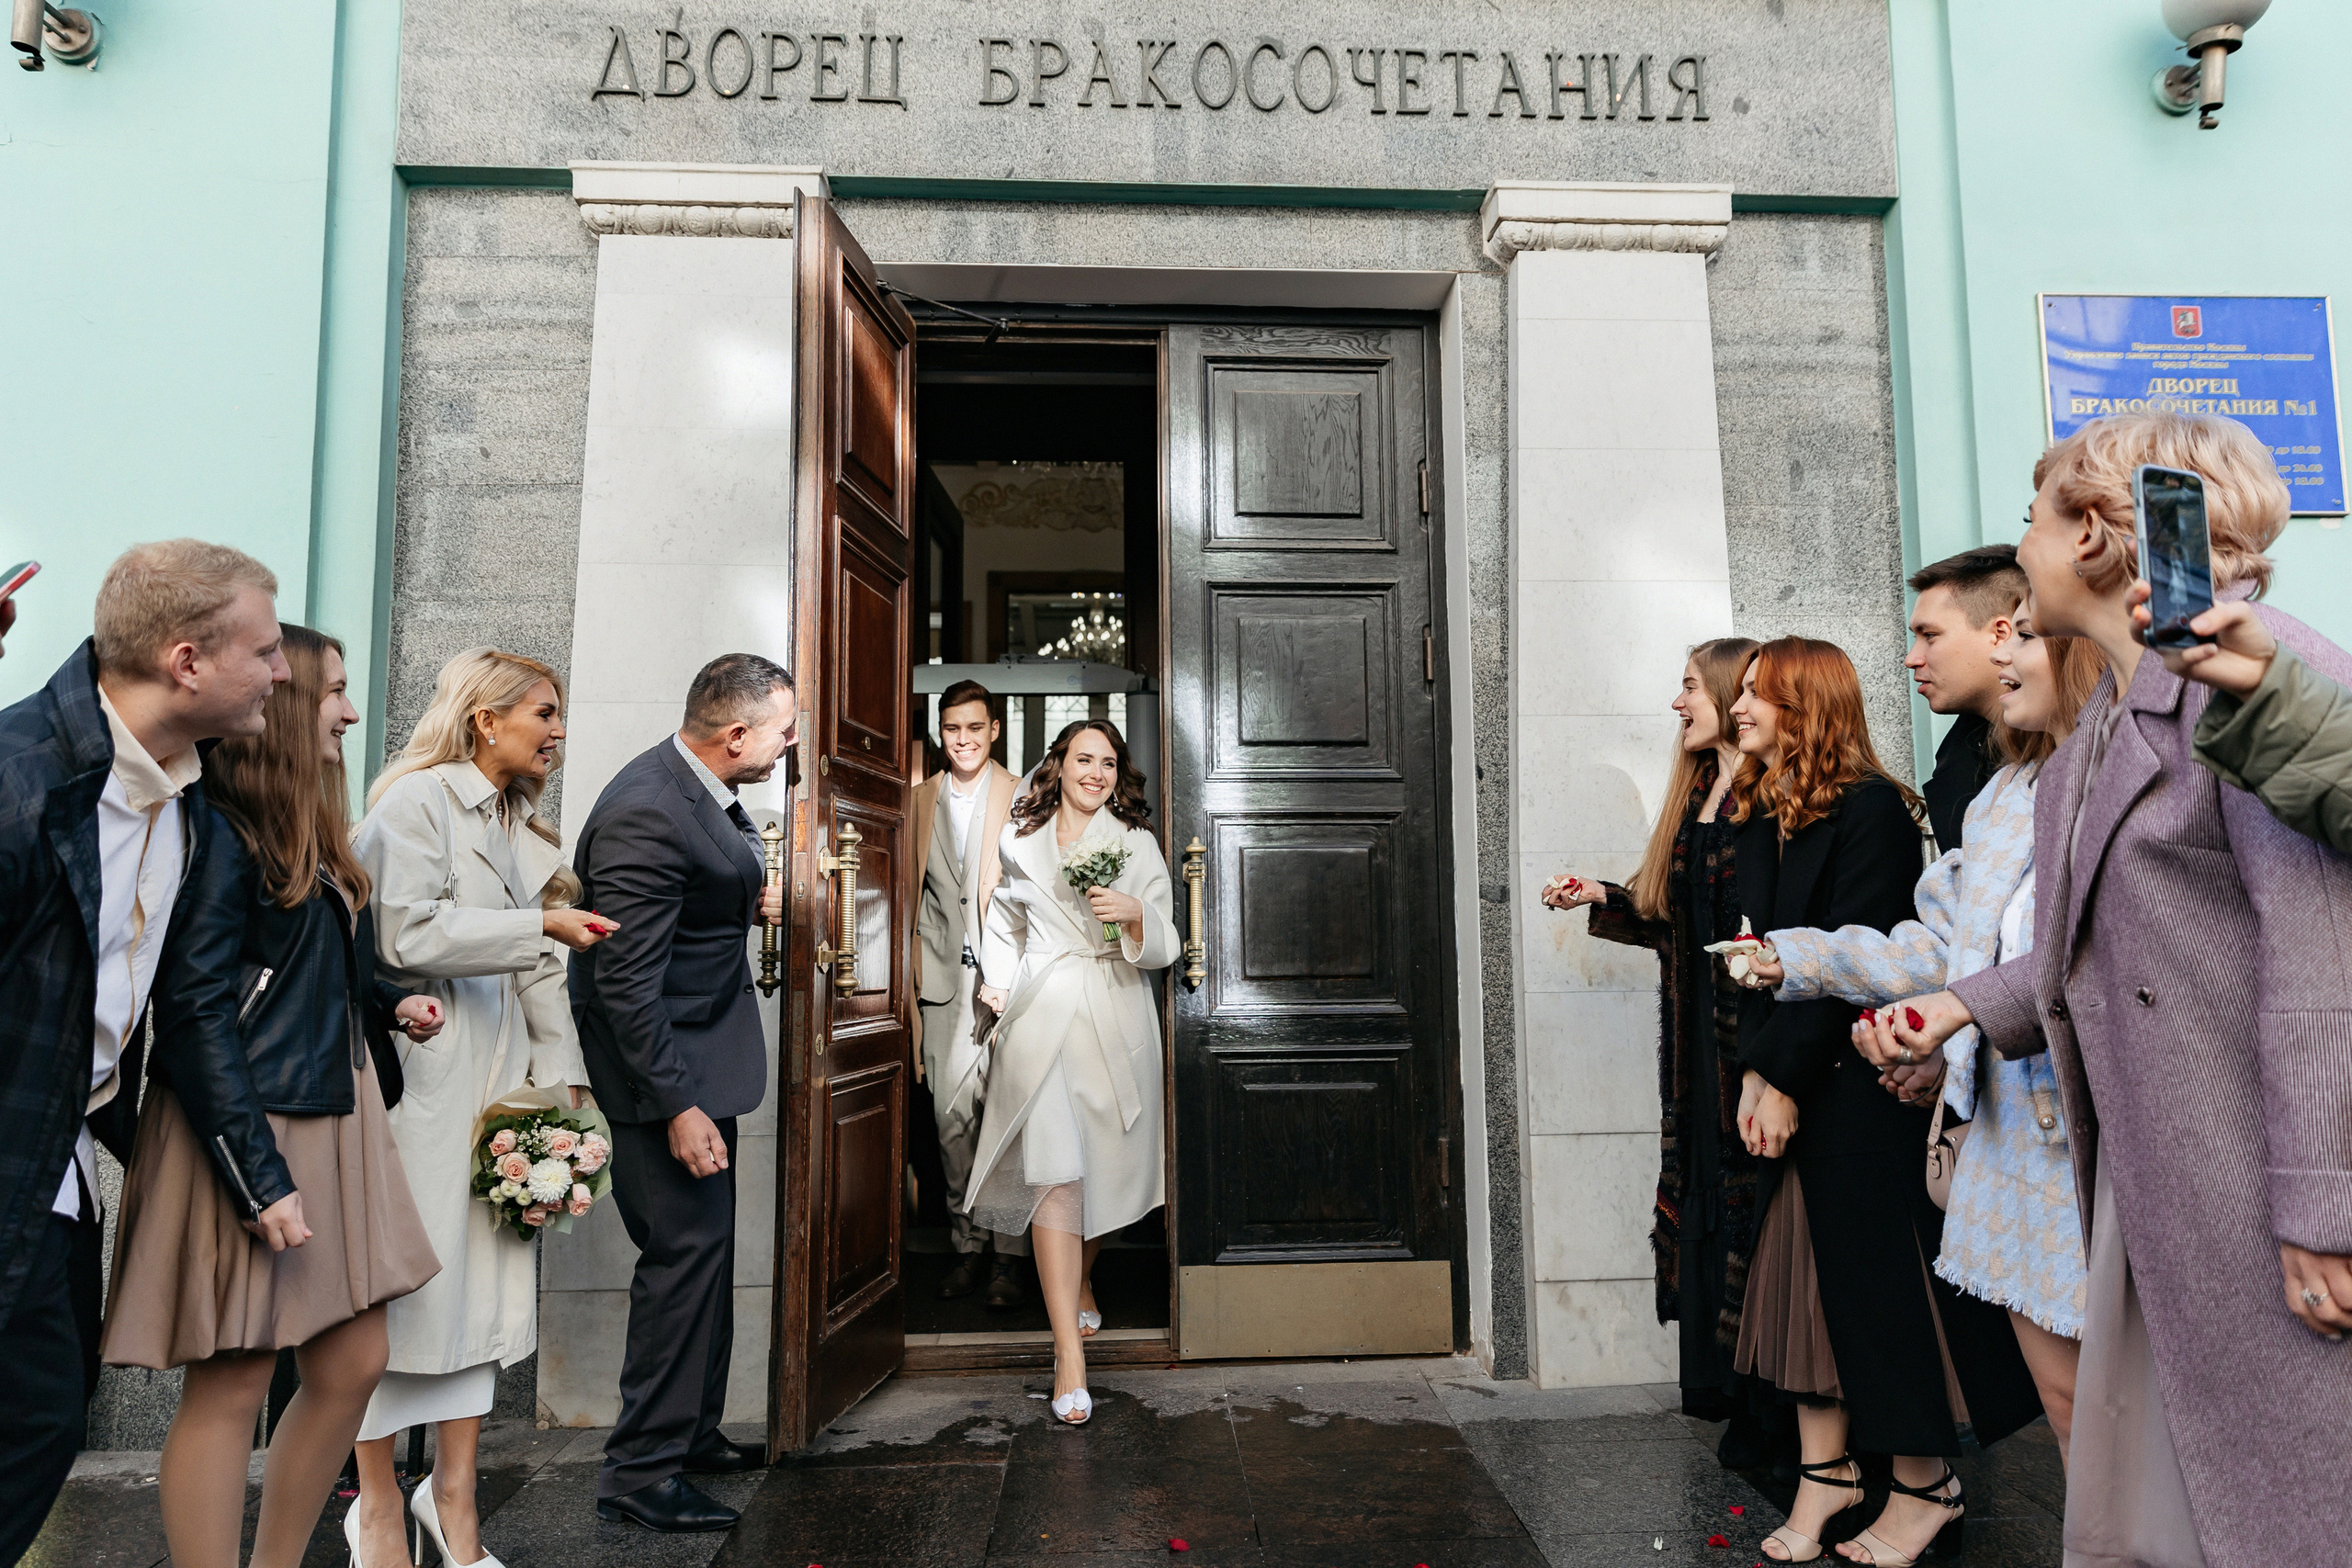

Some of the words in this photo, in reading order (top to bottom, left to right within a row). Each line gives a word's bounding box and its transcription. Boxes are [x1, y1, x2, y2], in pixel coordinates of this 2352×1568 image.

[591, 25, 908, 110] ДВОРЕЦ
[978, 37, 1711, 121] БРАКОСОЧЕТАНИЯ
[2146, 378, 2240, 397] ДВОРЕЦ
[2071, 398, 2279, 415] БРАКОСОЧЕТАНИЯ
[2284, 400, 2318, 415] №1
